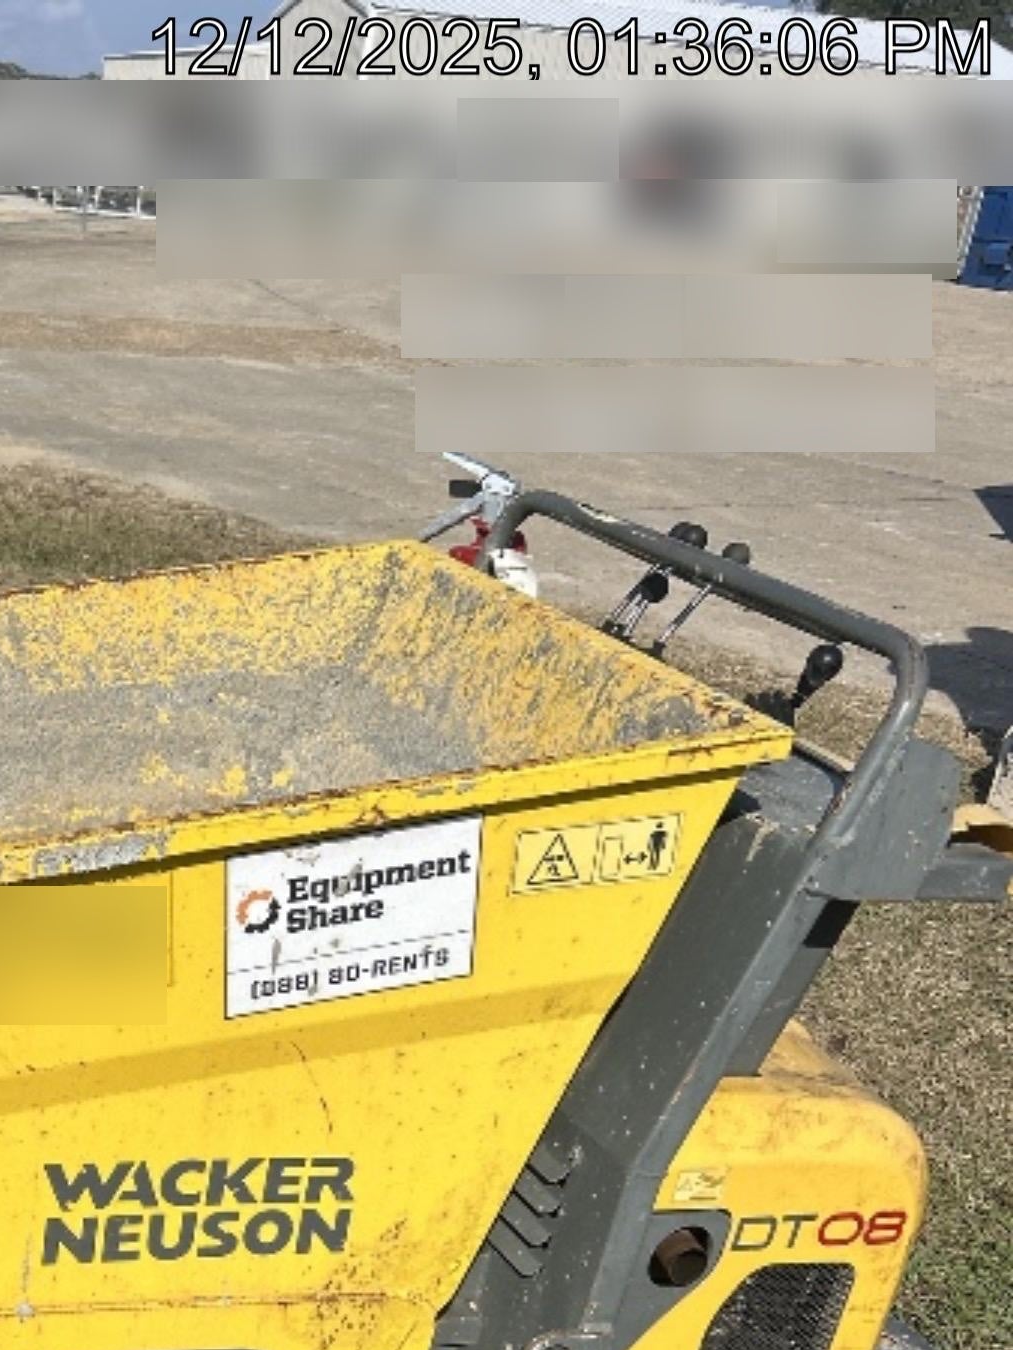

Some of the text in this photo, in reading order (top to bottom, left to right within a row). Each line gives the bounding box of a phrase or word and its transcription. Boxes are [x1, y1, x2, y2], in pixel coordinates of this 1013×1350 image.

[287, 850, 471, 903] Equipment
[286, 899, 384, 933] Share
[328, 945, 449, 985] 80-RENTS
[44, 1157, 355, 1212] WACKER
[41, 1209, 352, 1266] NEUSON
[732, 1211, 907, 1251] DT08
